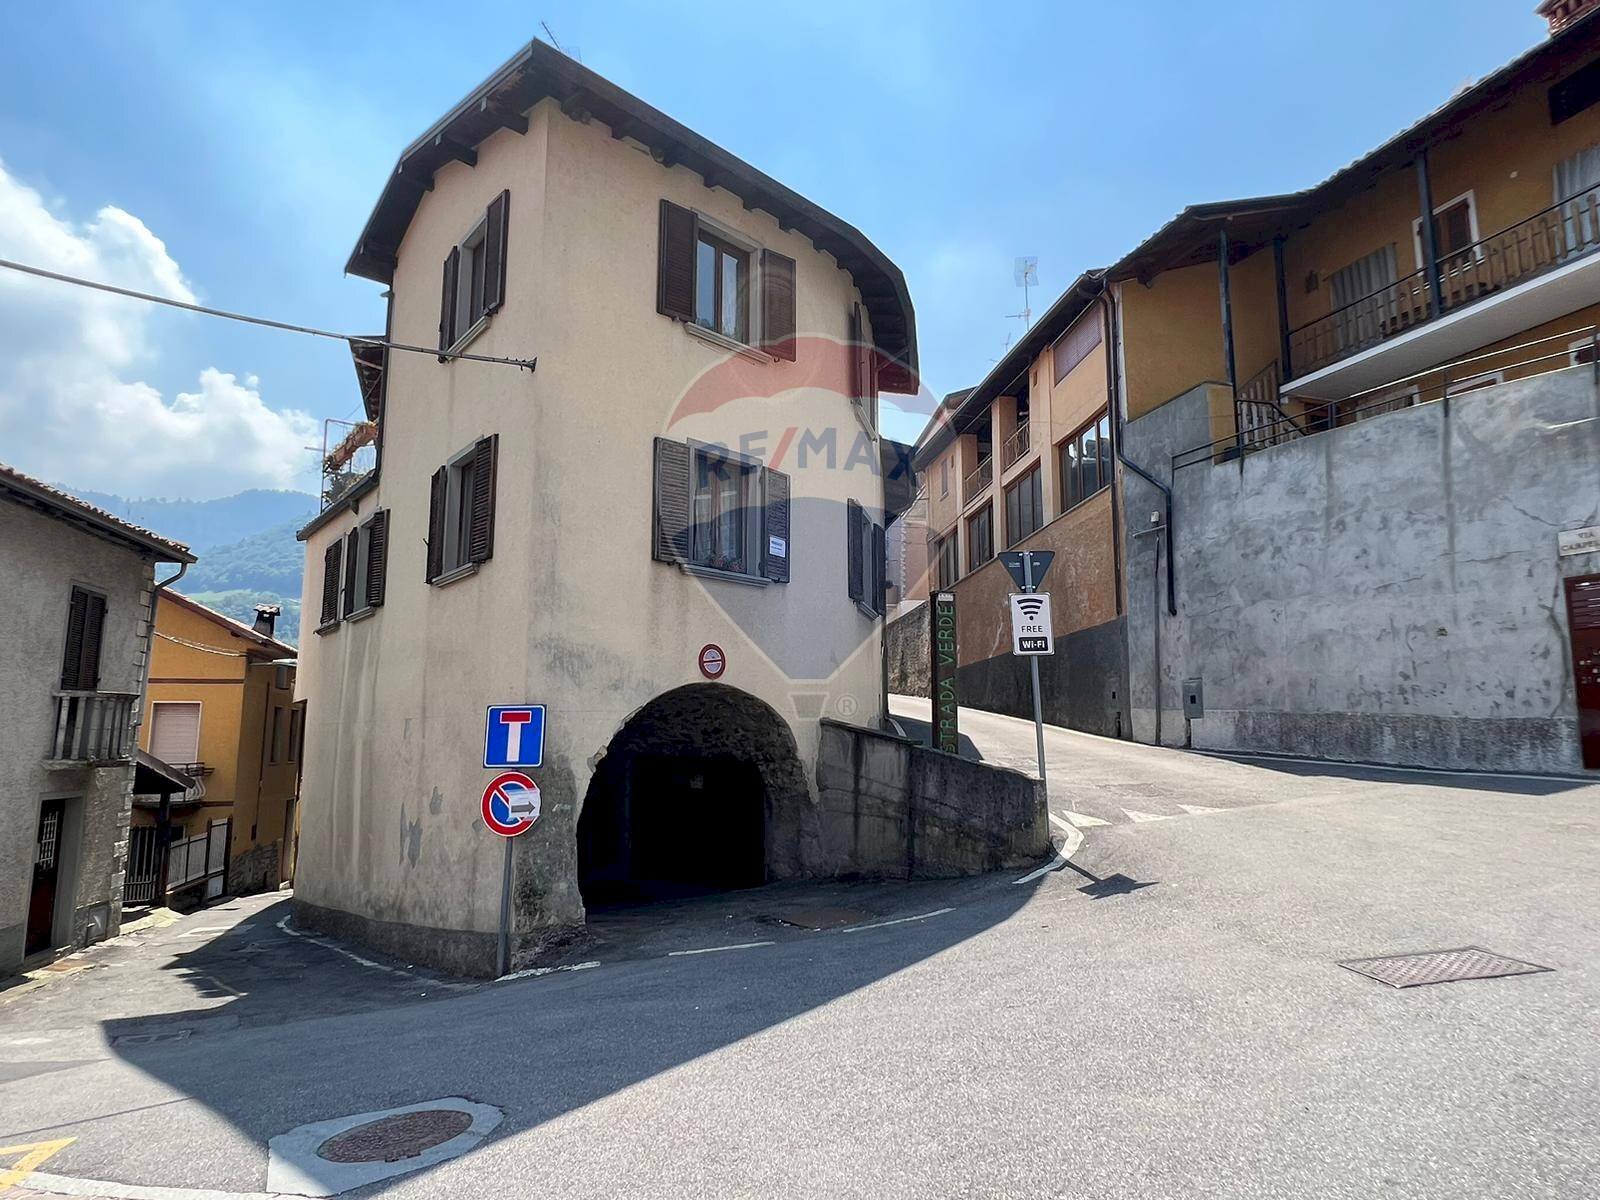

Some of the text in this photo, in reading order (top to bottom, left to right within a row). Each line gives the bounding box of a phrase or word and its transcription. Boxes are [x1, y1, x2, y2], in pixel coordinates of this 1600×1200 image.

[938, 605, 954, 666] VERDE
[1021, 625, 1043, 633] FREE
[1022, 640, 1045, 649] Wi-Fi
[940, 677, 956, 753] STRADA
